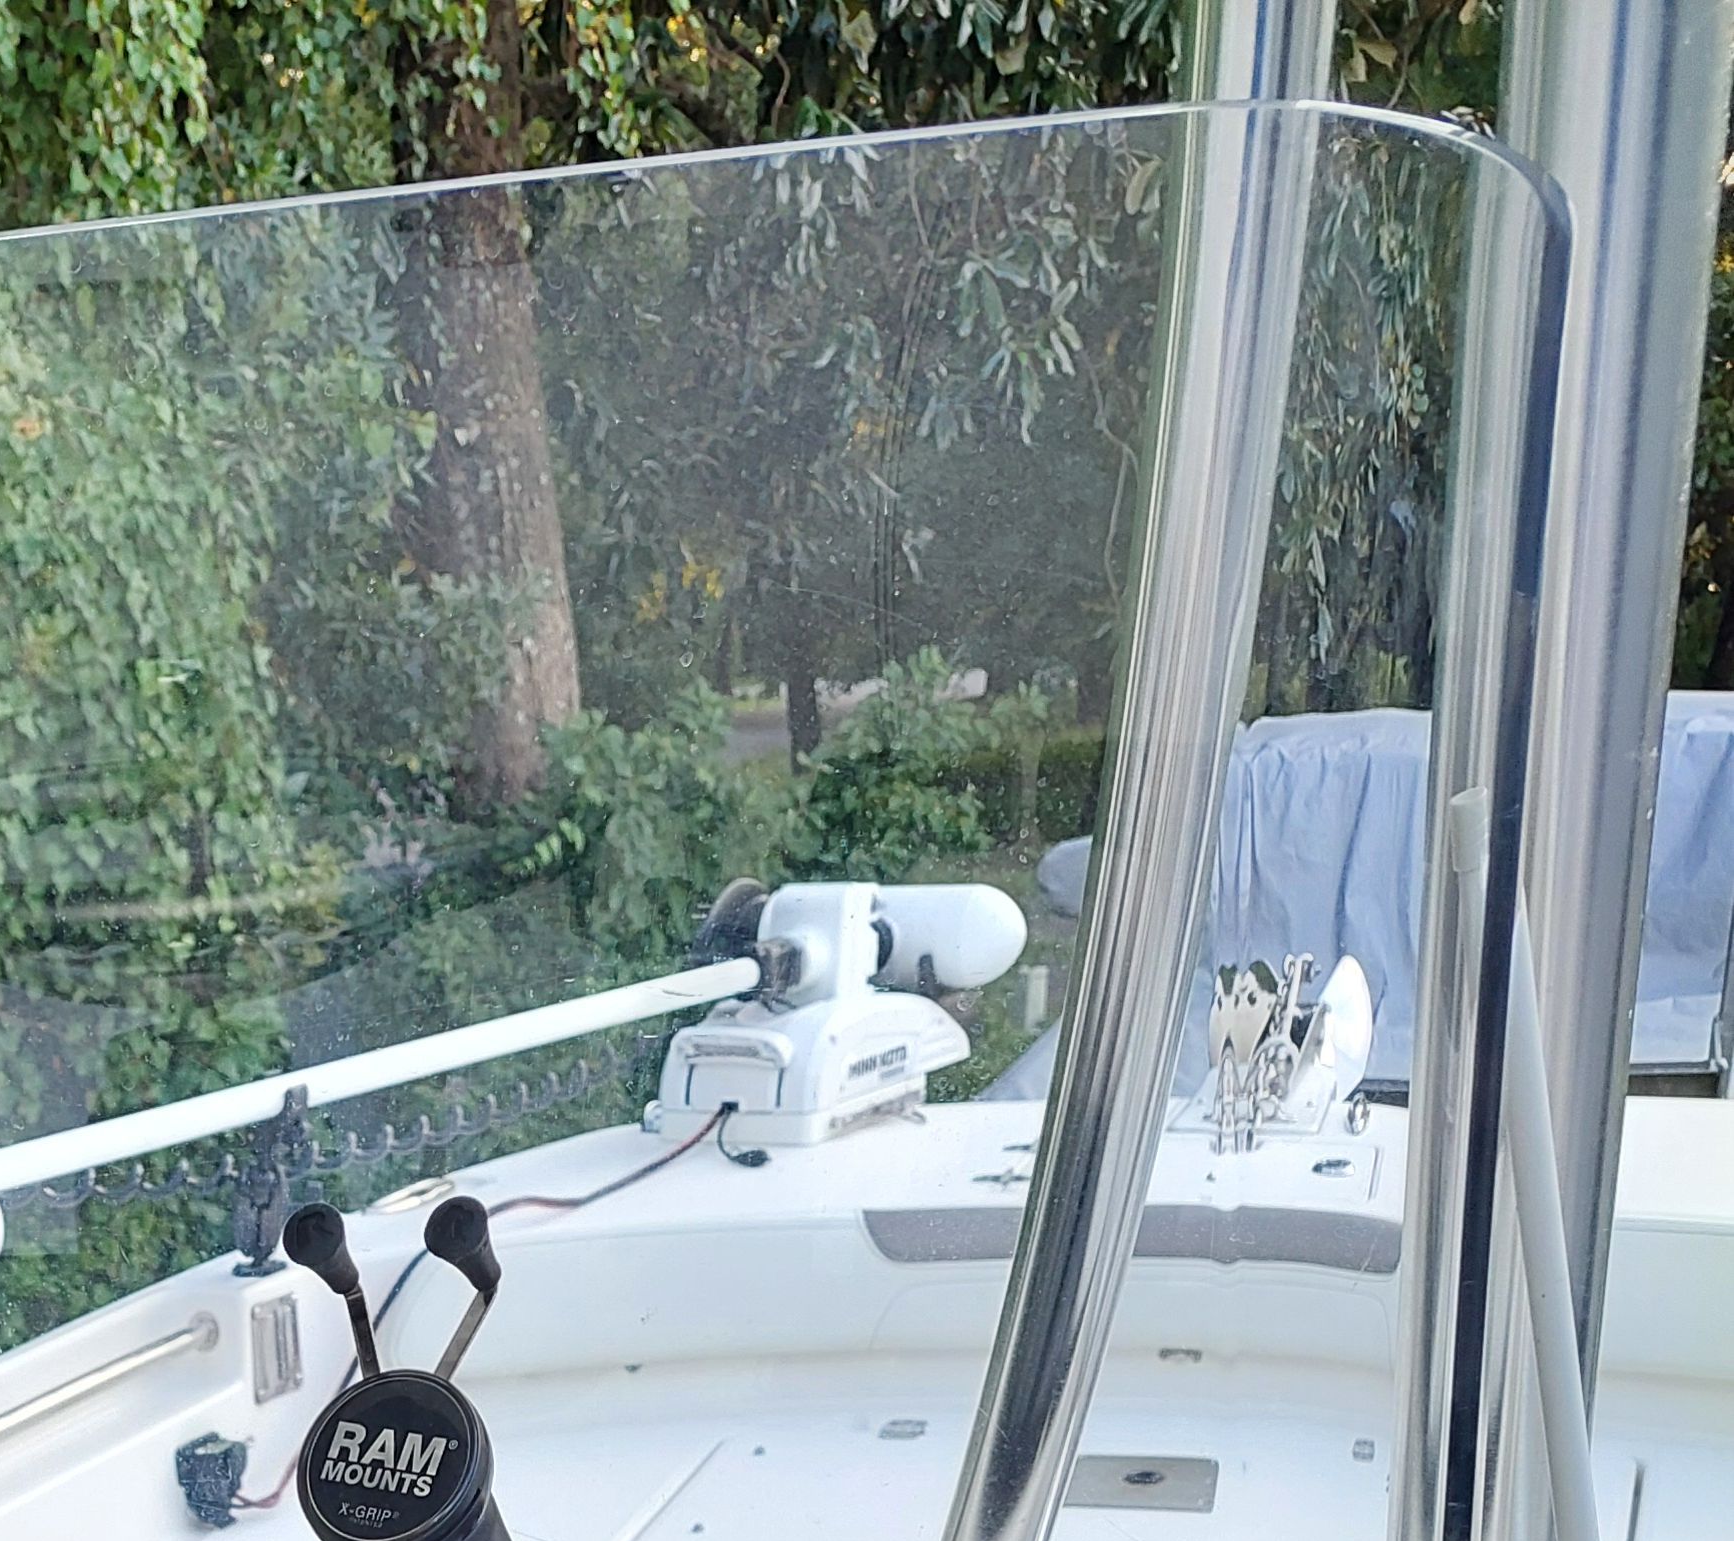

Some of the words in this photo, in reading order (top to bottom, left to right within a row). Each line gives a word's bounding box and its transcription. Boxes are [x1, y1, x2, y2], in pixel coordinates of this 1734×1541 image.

[327, 1421, 448, 1476] RAM
[320, 1460, 433, 1497] MOUNTS
[338, 1502, 392, 1521] X-GRIP
